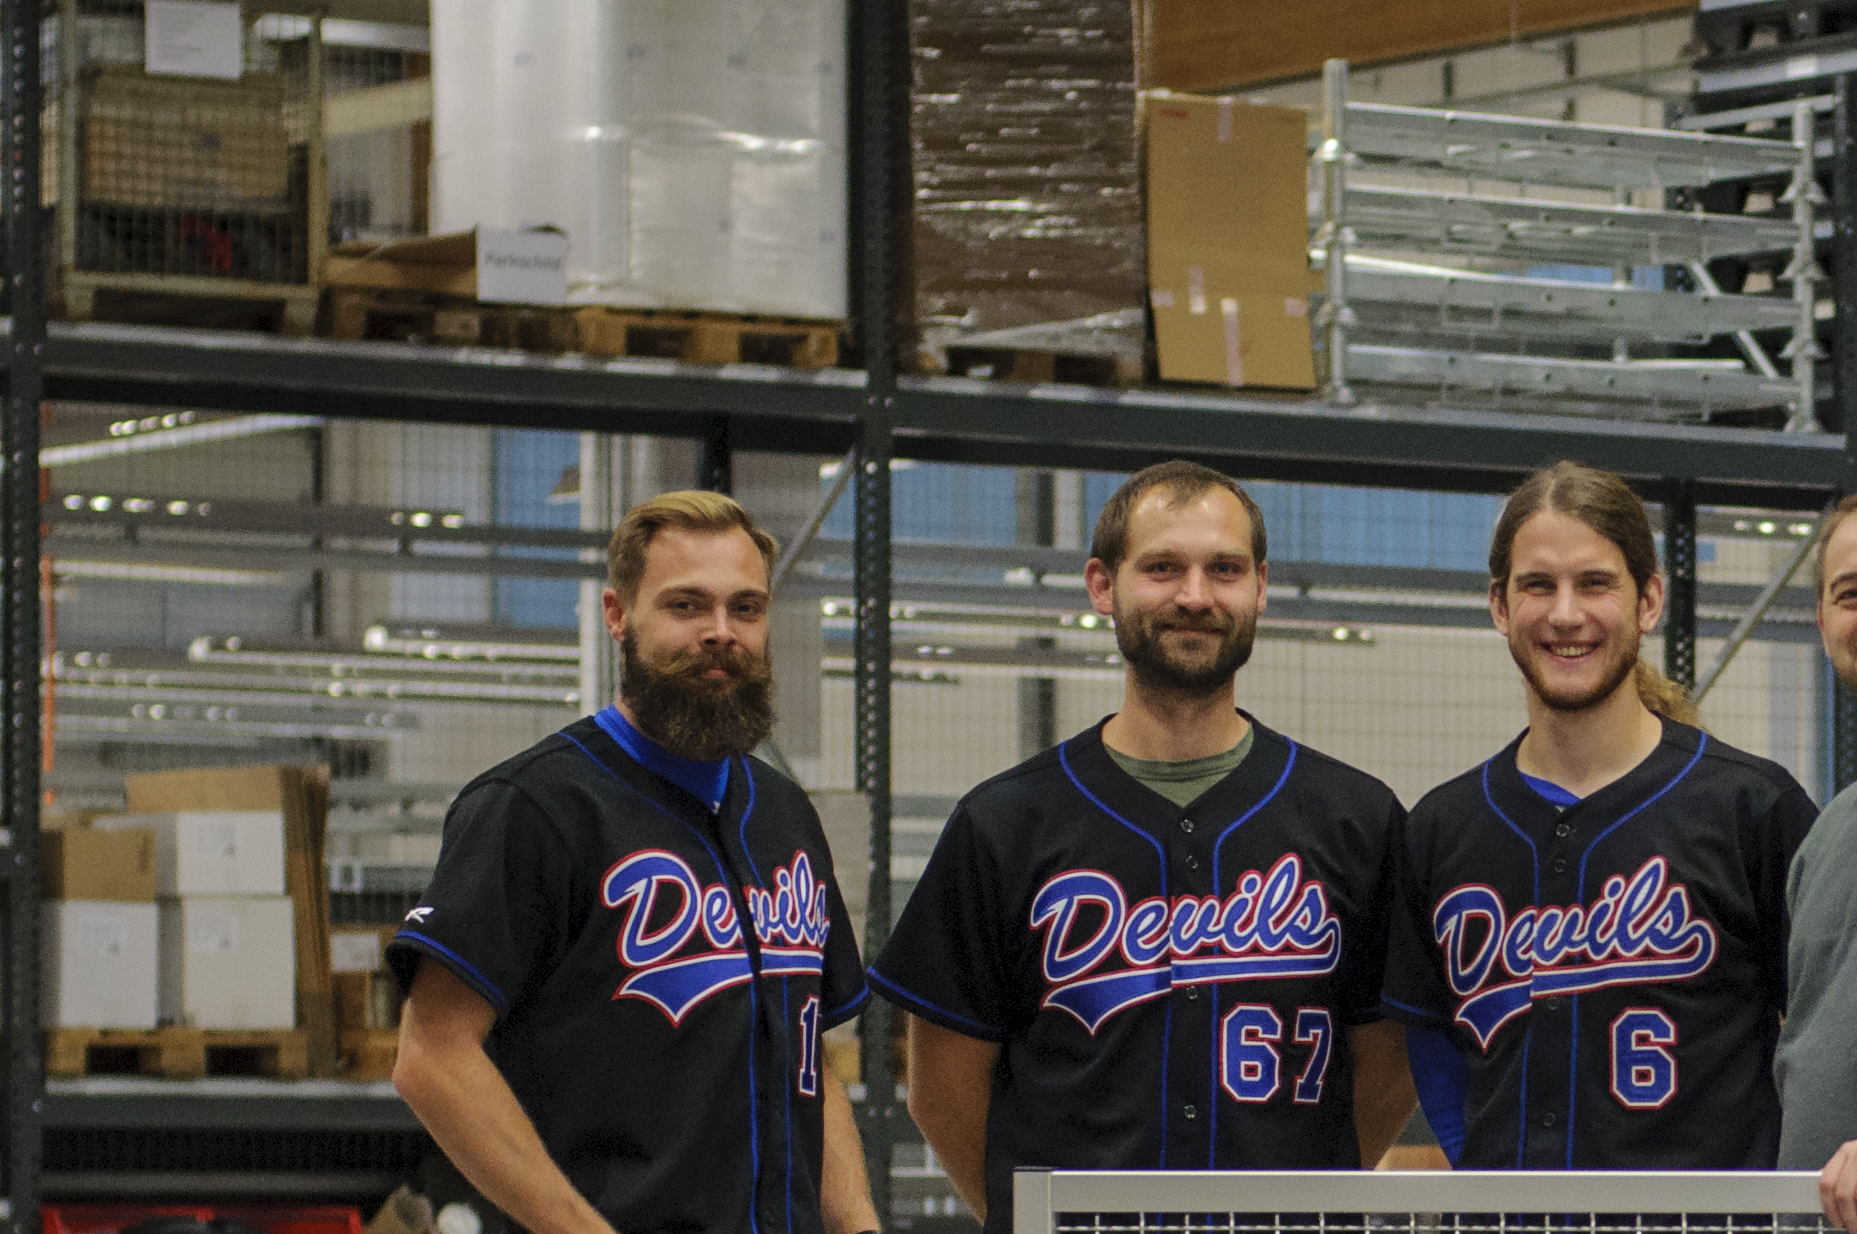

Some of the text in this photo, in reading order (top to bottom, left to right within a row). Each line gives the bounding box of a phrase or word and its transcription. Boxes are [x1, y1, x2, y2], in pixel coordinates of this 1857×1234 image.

[1030, 852, 1342, 985] Devils
[1433, 855, 1718, 1000] Devils
[1220, 1002, 1333, 1104] 67
[1609, 1007, 1678, 1110] 6
